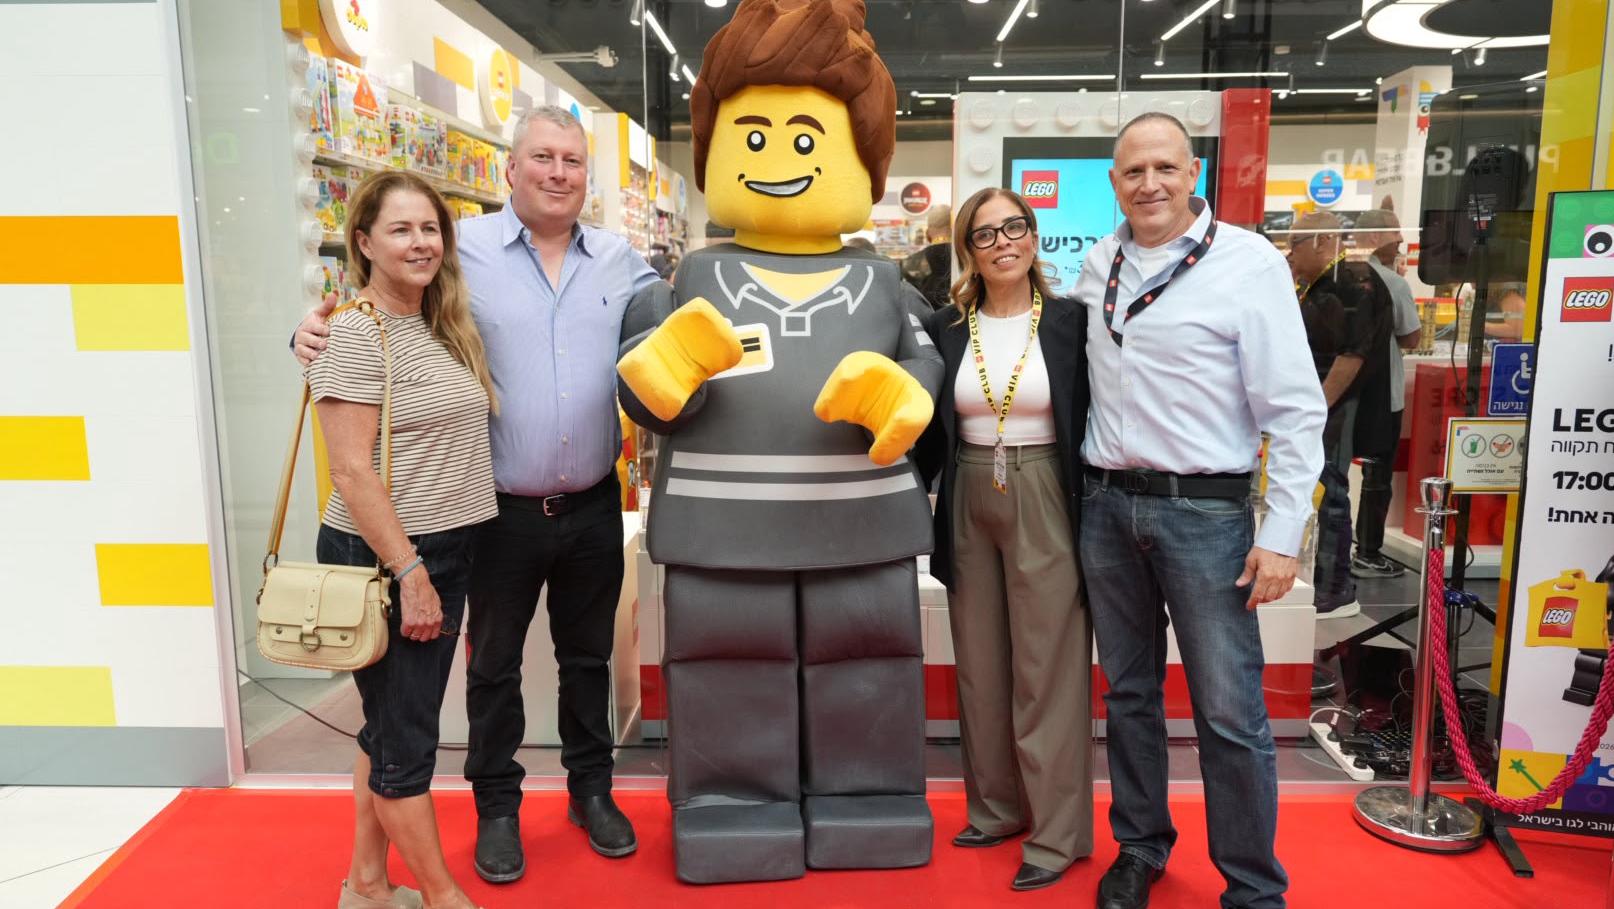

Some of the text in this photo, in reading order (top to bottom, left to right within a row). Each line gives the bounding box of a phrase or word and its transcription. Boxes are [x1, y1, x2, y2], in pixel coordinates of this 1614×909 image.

[1024, 182, 1056, 197] LEGO
[1566, 290, 1610, 307] LEGO
[969, 310, 981, 354] VIP CLUB
[979, 367, 990, 394] CLUB
[1007, 374, 1018, 392] VIP
[1493, 401, 1524, 410] נגישה
[1552, 408, 1614, 433] LEG
[1551, 440, 1599, 456] תקווה
[1552, 470, 1614, 491] 17:00
[1548, 507, 1598, 523] אחת!
[1542, 609, 1572, 625] LEGO
[1566, 818, 1584, 828] לגו
